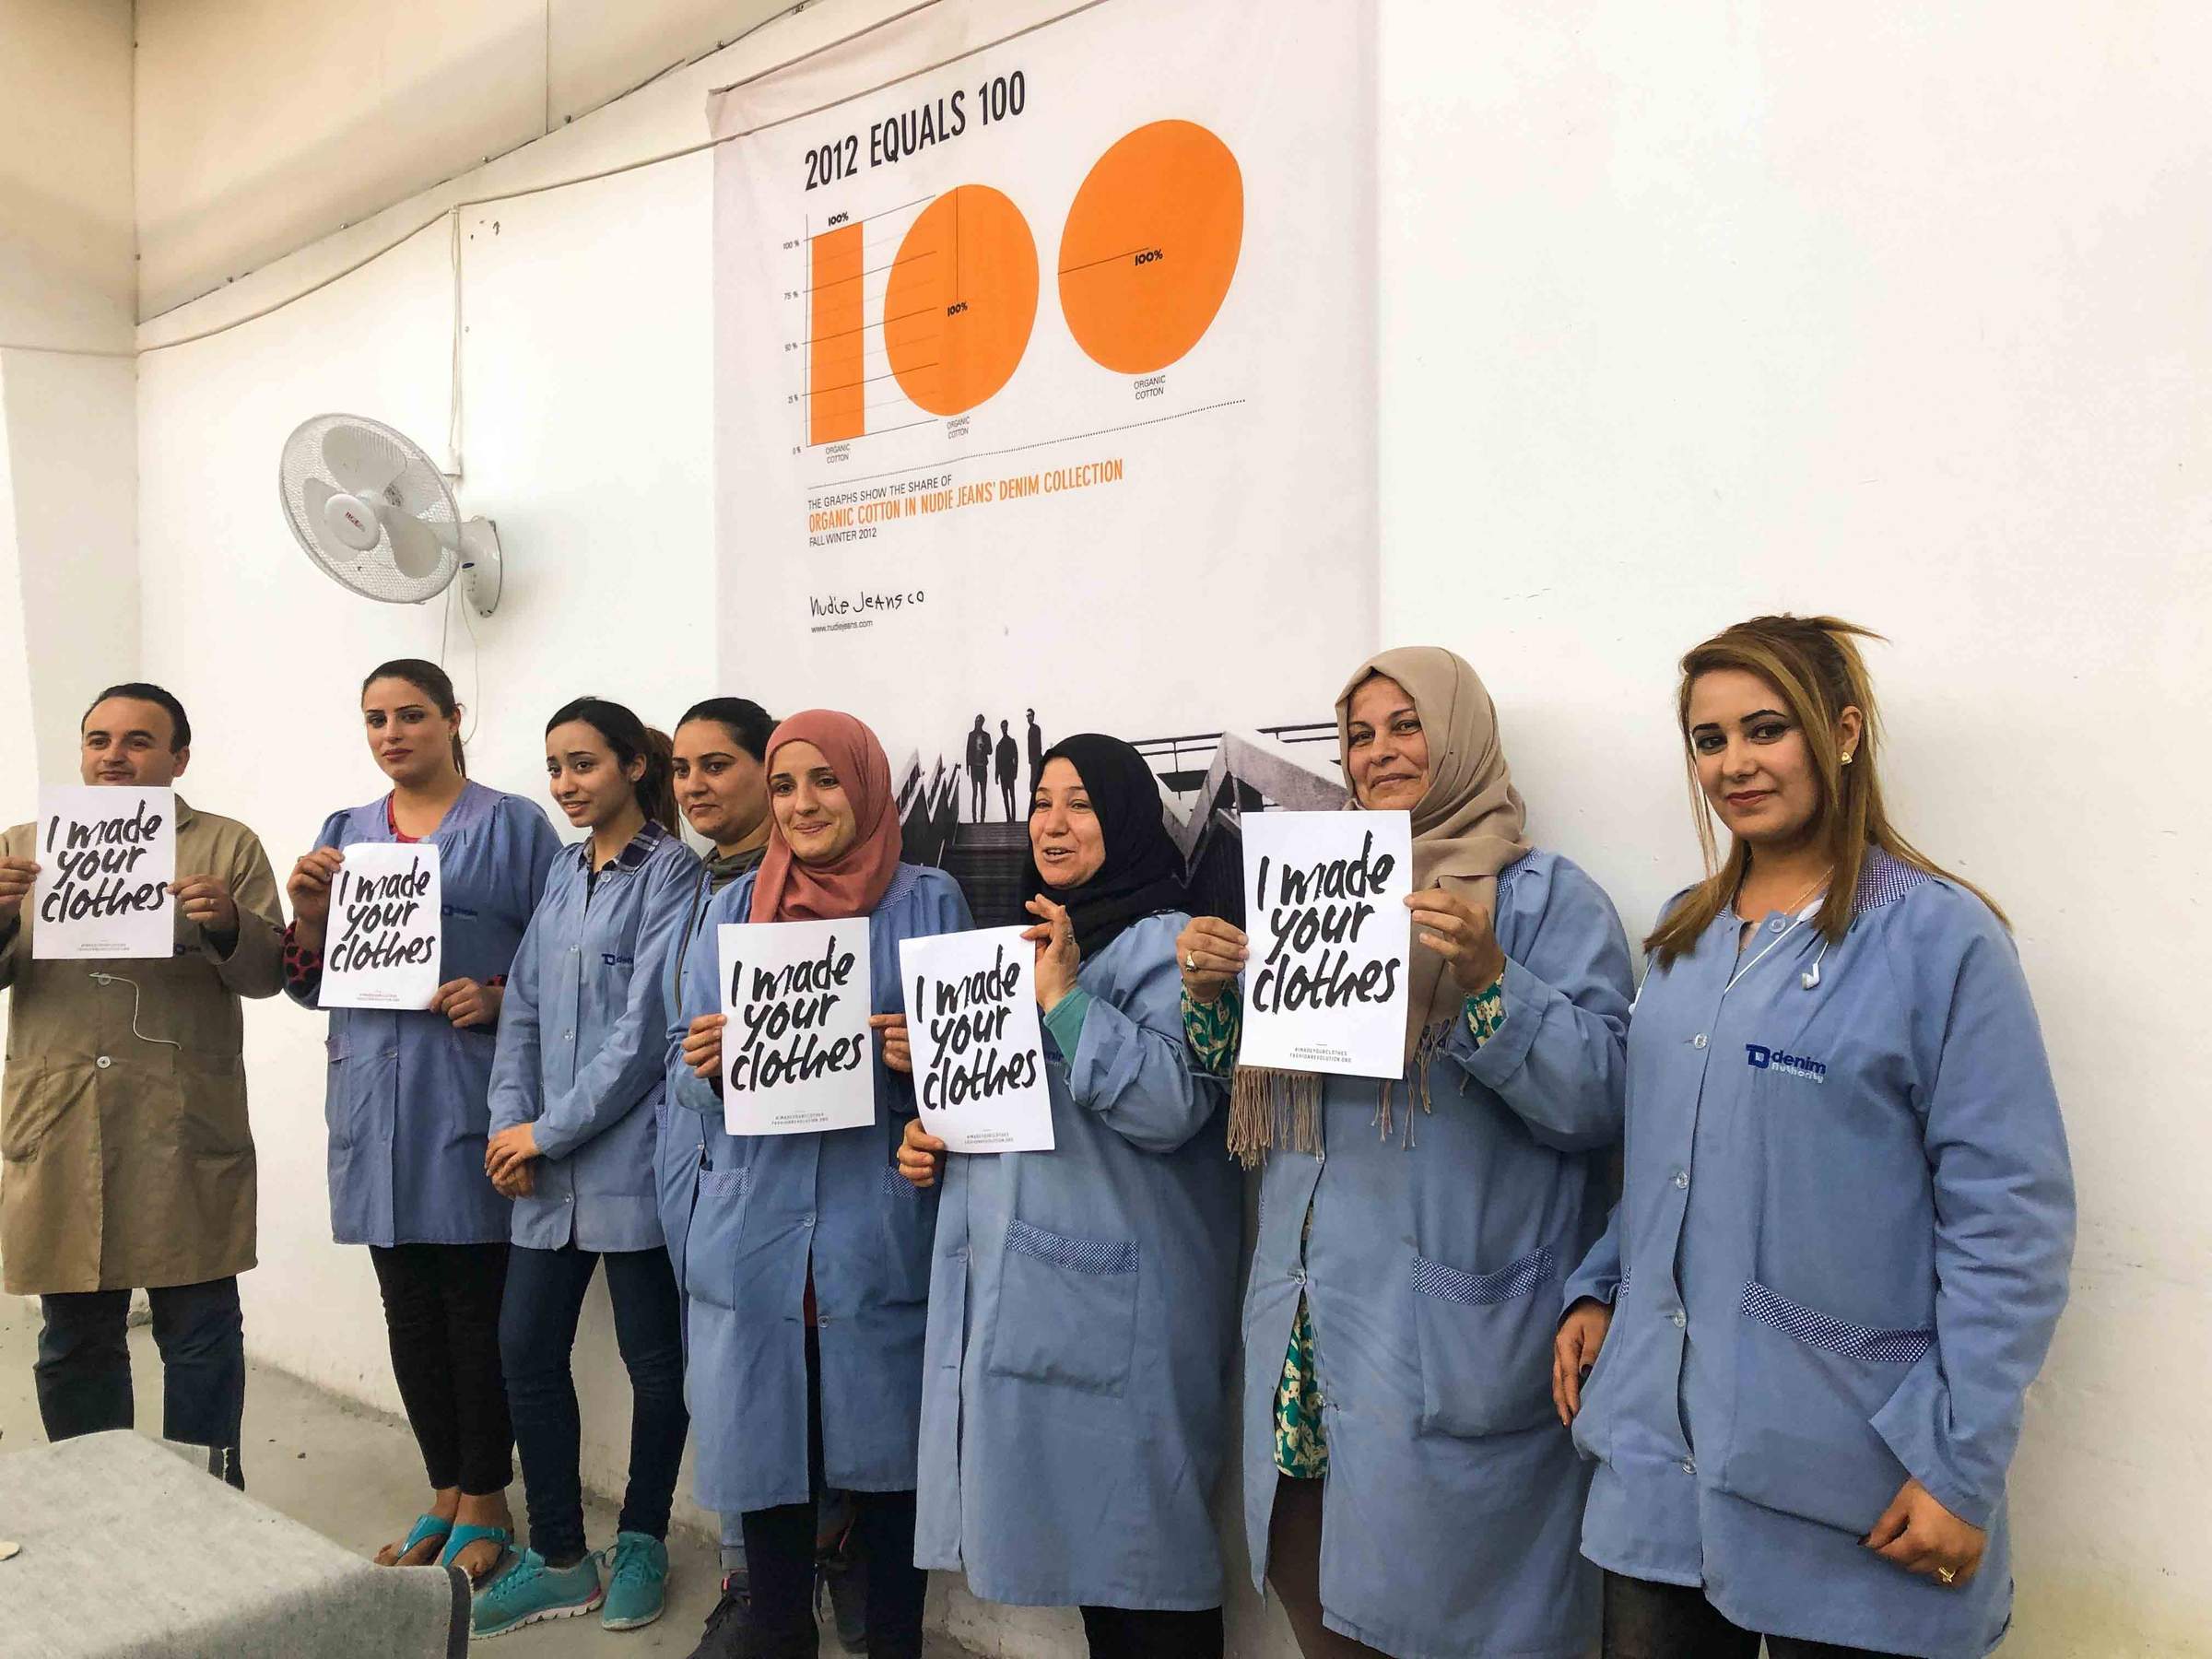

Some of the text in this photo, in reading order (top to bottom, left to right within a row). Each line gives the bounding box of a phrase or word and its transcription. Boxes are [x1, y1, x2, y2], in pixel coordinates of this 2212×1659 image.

[805, 70, 1025, 191] 2012 EQUALS 100
[828, 212, 849, 226] 100%
[1135, 249, 1163, 266] 100%
[947, 301, 968, 317] 100%
[1134, 375, 1166, 390] ORGANIC
[1135, 387, 1164, 400] COTTON
[947, 417, 971, 429] ORGANIC
[947, 428, 969, 440] COTTON
[826, 443, 850, 454] ORGANIC
[826, 453, 849, 465] COTTON
[808, 475, 952, 510] THE GRAPHS SHOW THE SHARE OF
[809, 459, 1124, 534] ORGANIC COTTON IN NUDIE JEANS' DENIM COLLECTION
[809, 527, 877, 547] FALL WINTER 2012
[47, 799, 163, 853] I made
[53, 845, 147, 890] your
[338, 855, 431, 906] I made
[1257, 830, 1395, 912] I made
[41, 877, 169, 924] clothes
[342, 900, 419, 942] your
[330, 930, 436, 973] clothes
[1265, 900, 1376, 966] your
[731, 935, 856, 1007] I made
[916, 944, 1021, 1024] I made
[1253, 948, 1401, 1015] clothes
[740, 993, 841, 1053] your
[930, 1005, 1012, 1069] your
[730, 1032, 865, 1092] clothes
[923, 1047, 1037, 1111] clothes
[1771, 1050, 1827, 1075] denim
